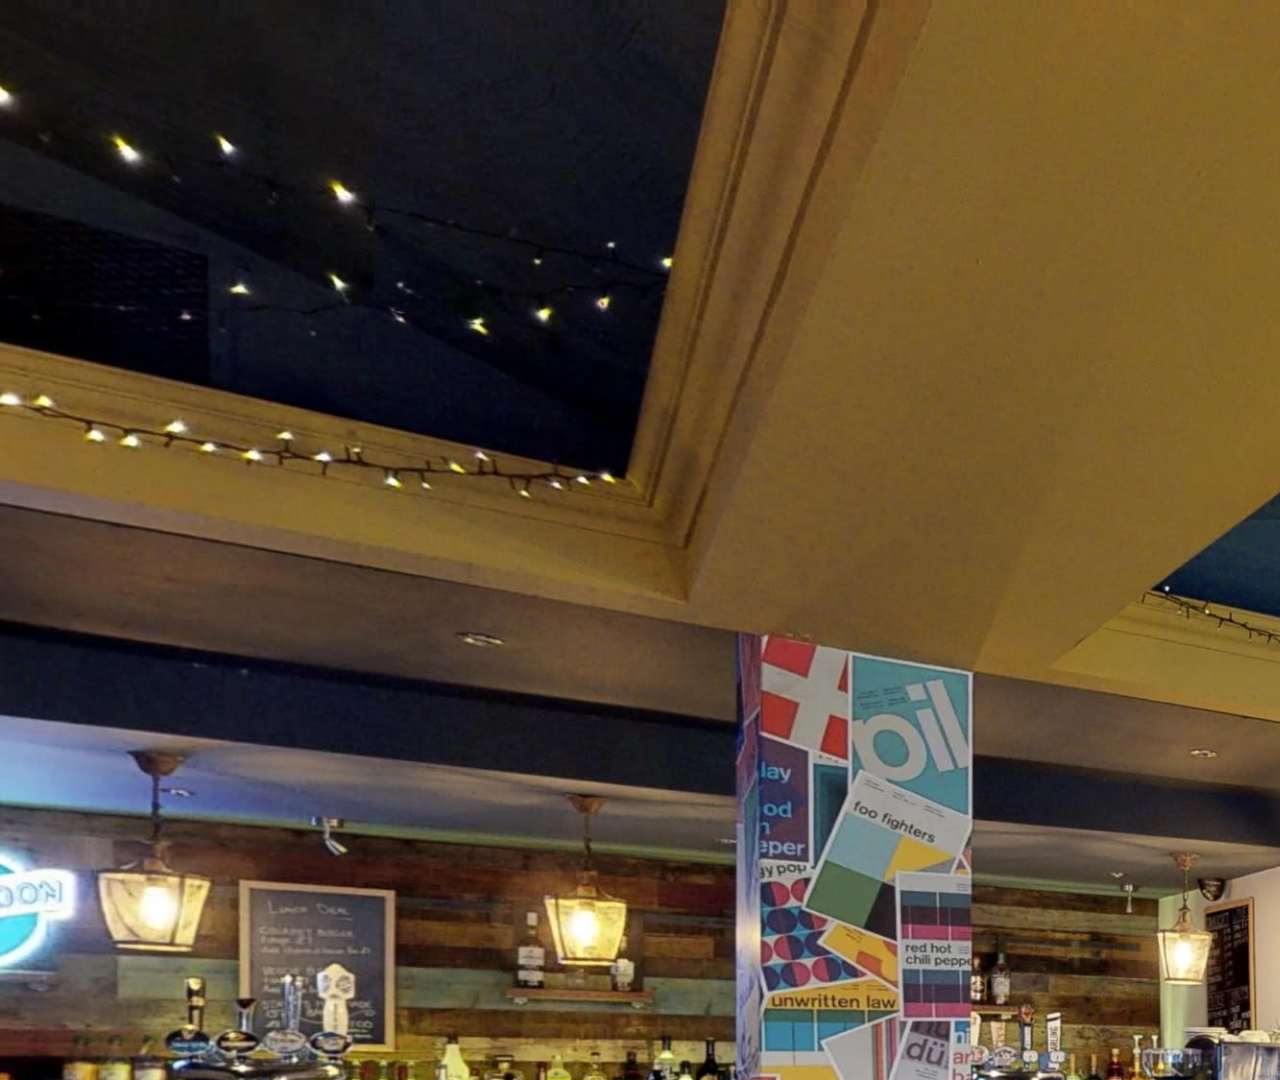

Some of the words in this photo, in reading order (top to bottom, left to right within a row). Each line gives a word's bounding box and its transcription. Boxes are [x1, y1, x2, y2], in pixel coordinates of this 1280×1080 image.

[853, 801, 878, 820] foo
[881, 812, 937, 845] fighters
[905, 942, 927, 953] red
[930, 943, 952, 954] hot
[905, 956, 931, 966] chili
[771, 993, 860, 1009] unwritten
[866, 994, 896, 1009] law
